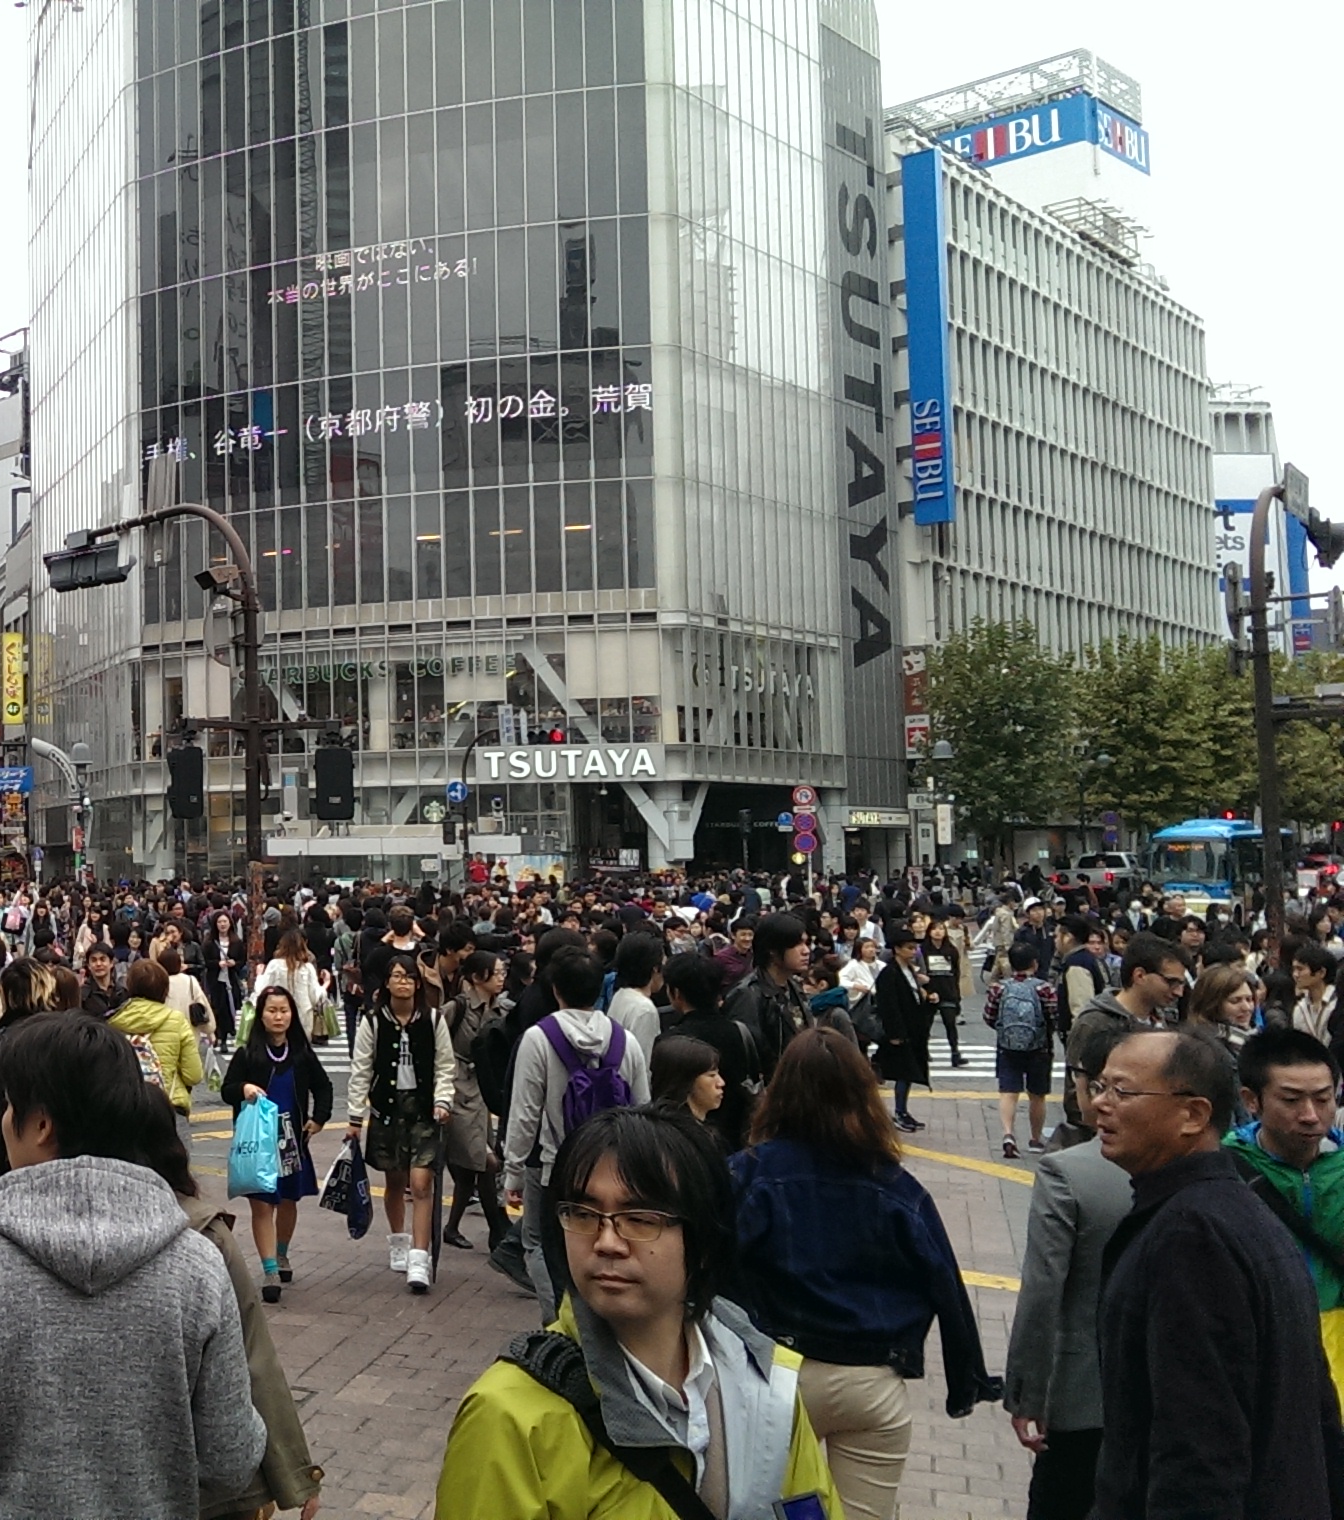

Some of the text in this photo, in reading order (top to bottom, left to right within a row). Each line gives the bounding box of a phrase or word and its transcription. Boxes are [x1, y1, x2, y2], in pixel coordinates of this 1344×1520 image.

[942, 108, 1063, 160] EIBU
[591, 382, 653, 414] 荒賀
[836, 117, 891, 667] TSUTAYA
[913, 398, 945, 502] SEIBU
[731, 666, 815, 699] TSUTAYA
[484, 748, 656, 779] TSUTAYA
